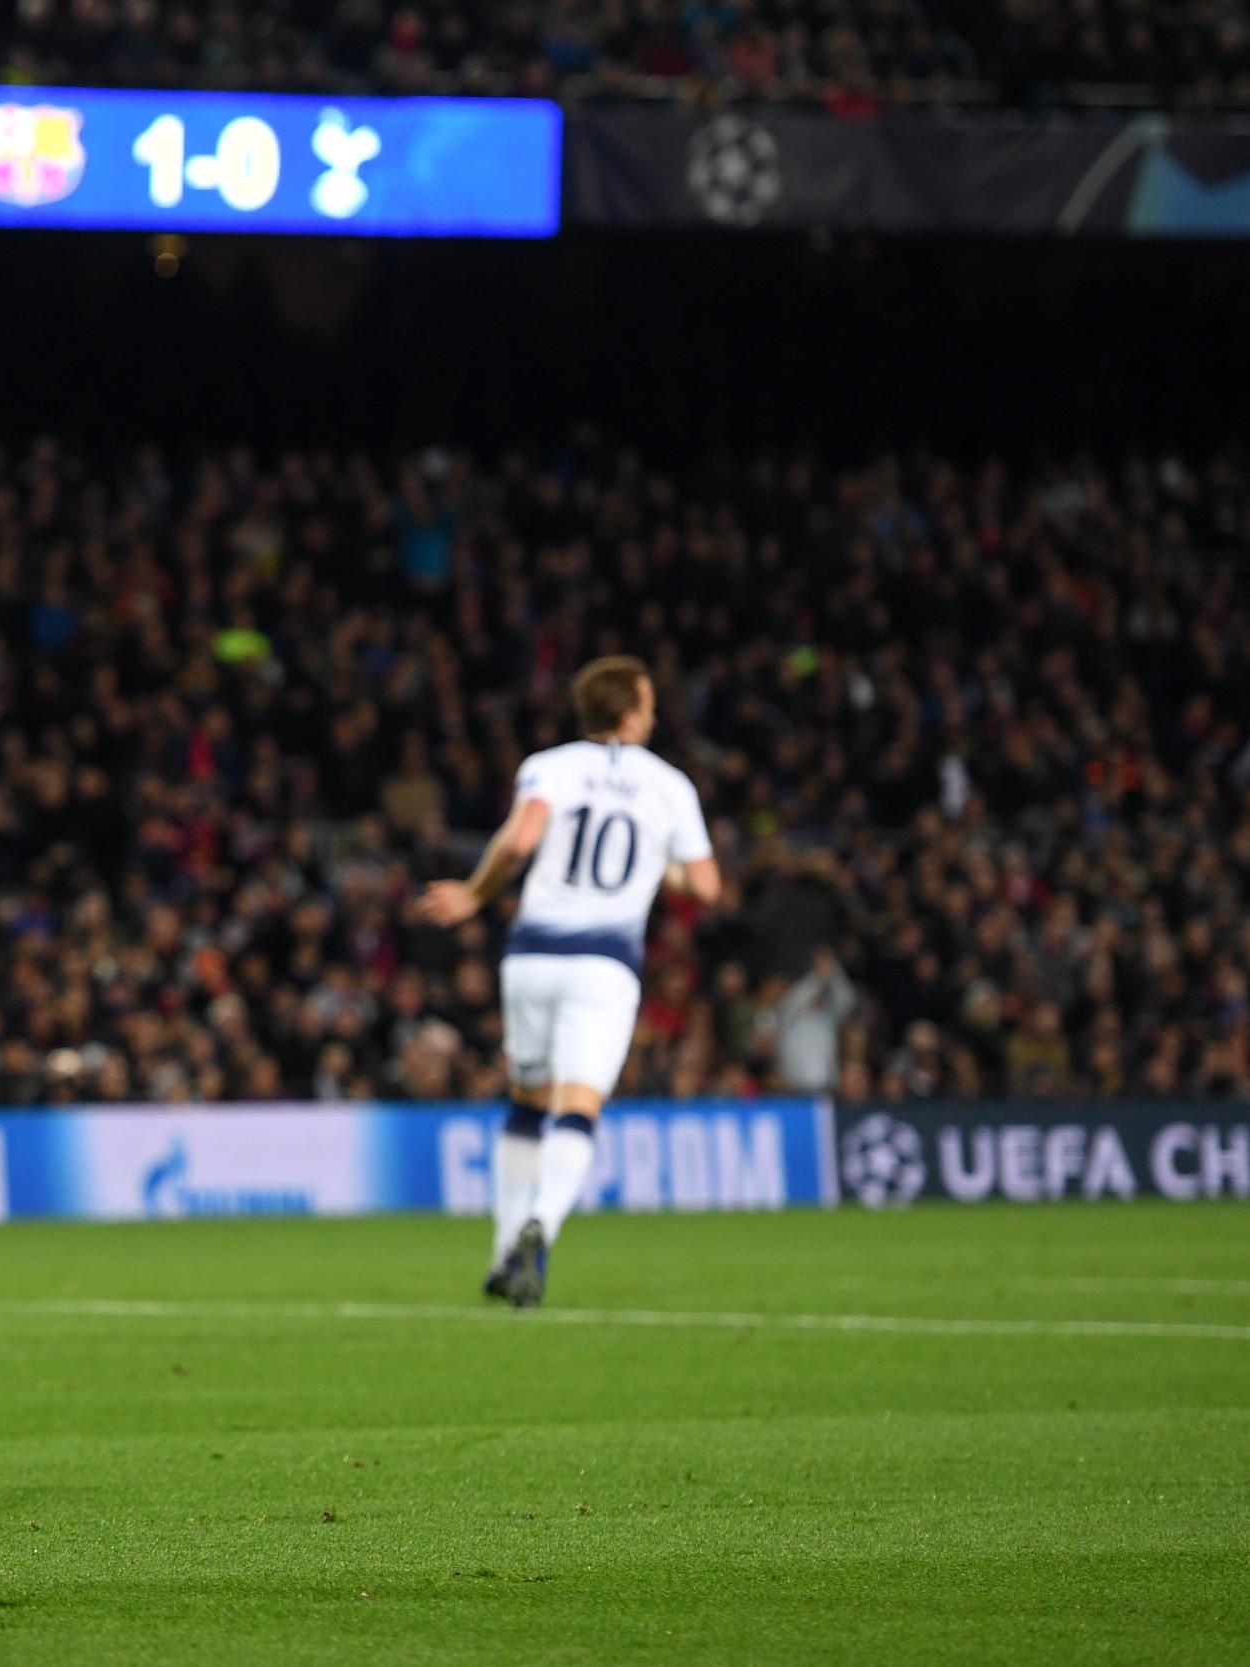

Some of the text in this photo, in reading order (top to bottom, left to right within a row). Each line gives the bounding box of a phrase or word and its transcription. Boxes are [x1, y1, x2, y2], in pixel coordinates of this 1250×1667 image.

[132, 113, 281, 212] 1-0
[563, 804, 638, 896] 10
[439, 1116, 786, 1214] GPROM
[938, 1126, 1136, 1201] UEFA
